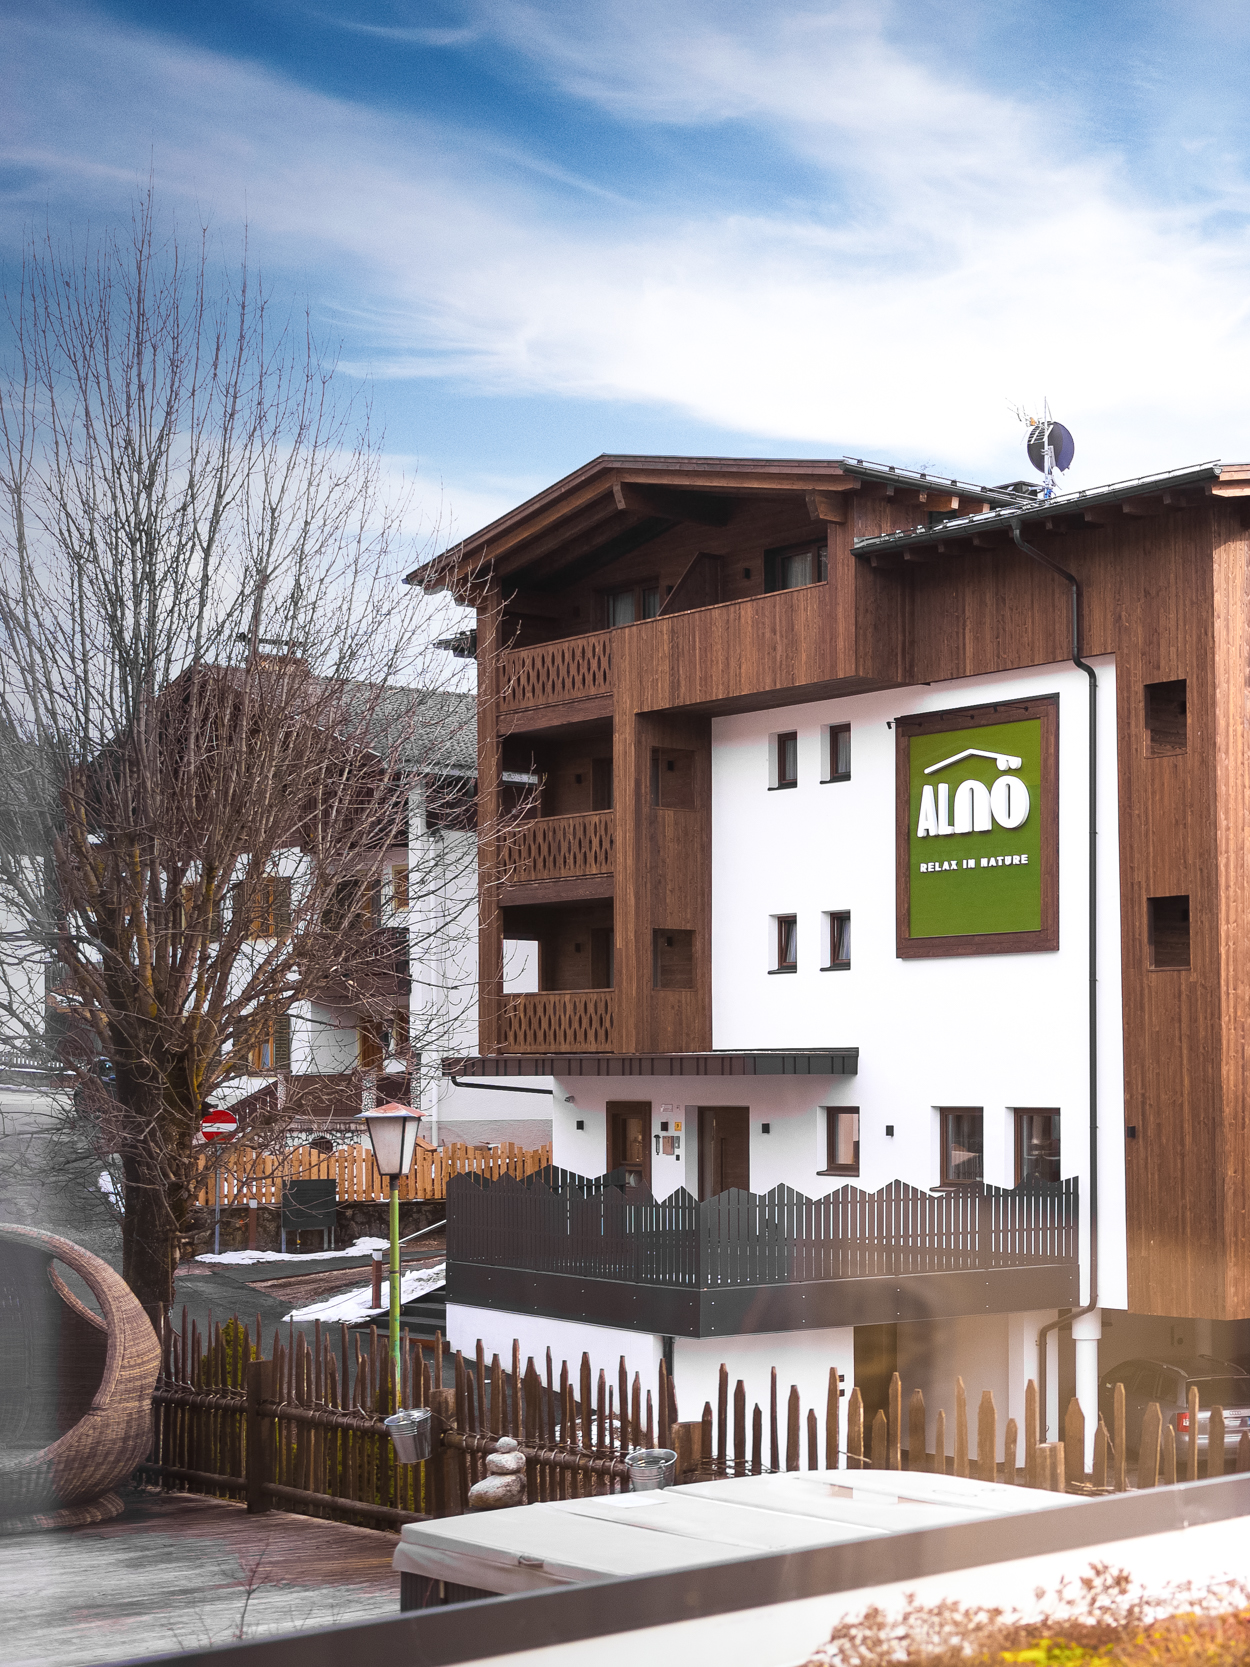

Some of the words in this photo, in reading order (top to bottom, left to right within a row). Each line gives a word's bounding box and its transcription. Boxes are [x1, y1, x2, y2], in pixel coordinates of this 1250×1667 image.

[920, 860, 958, 873] RELAX
[962, 859, 976, 869] IN
[980, 854, 1028, 868] NATURE
